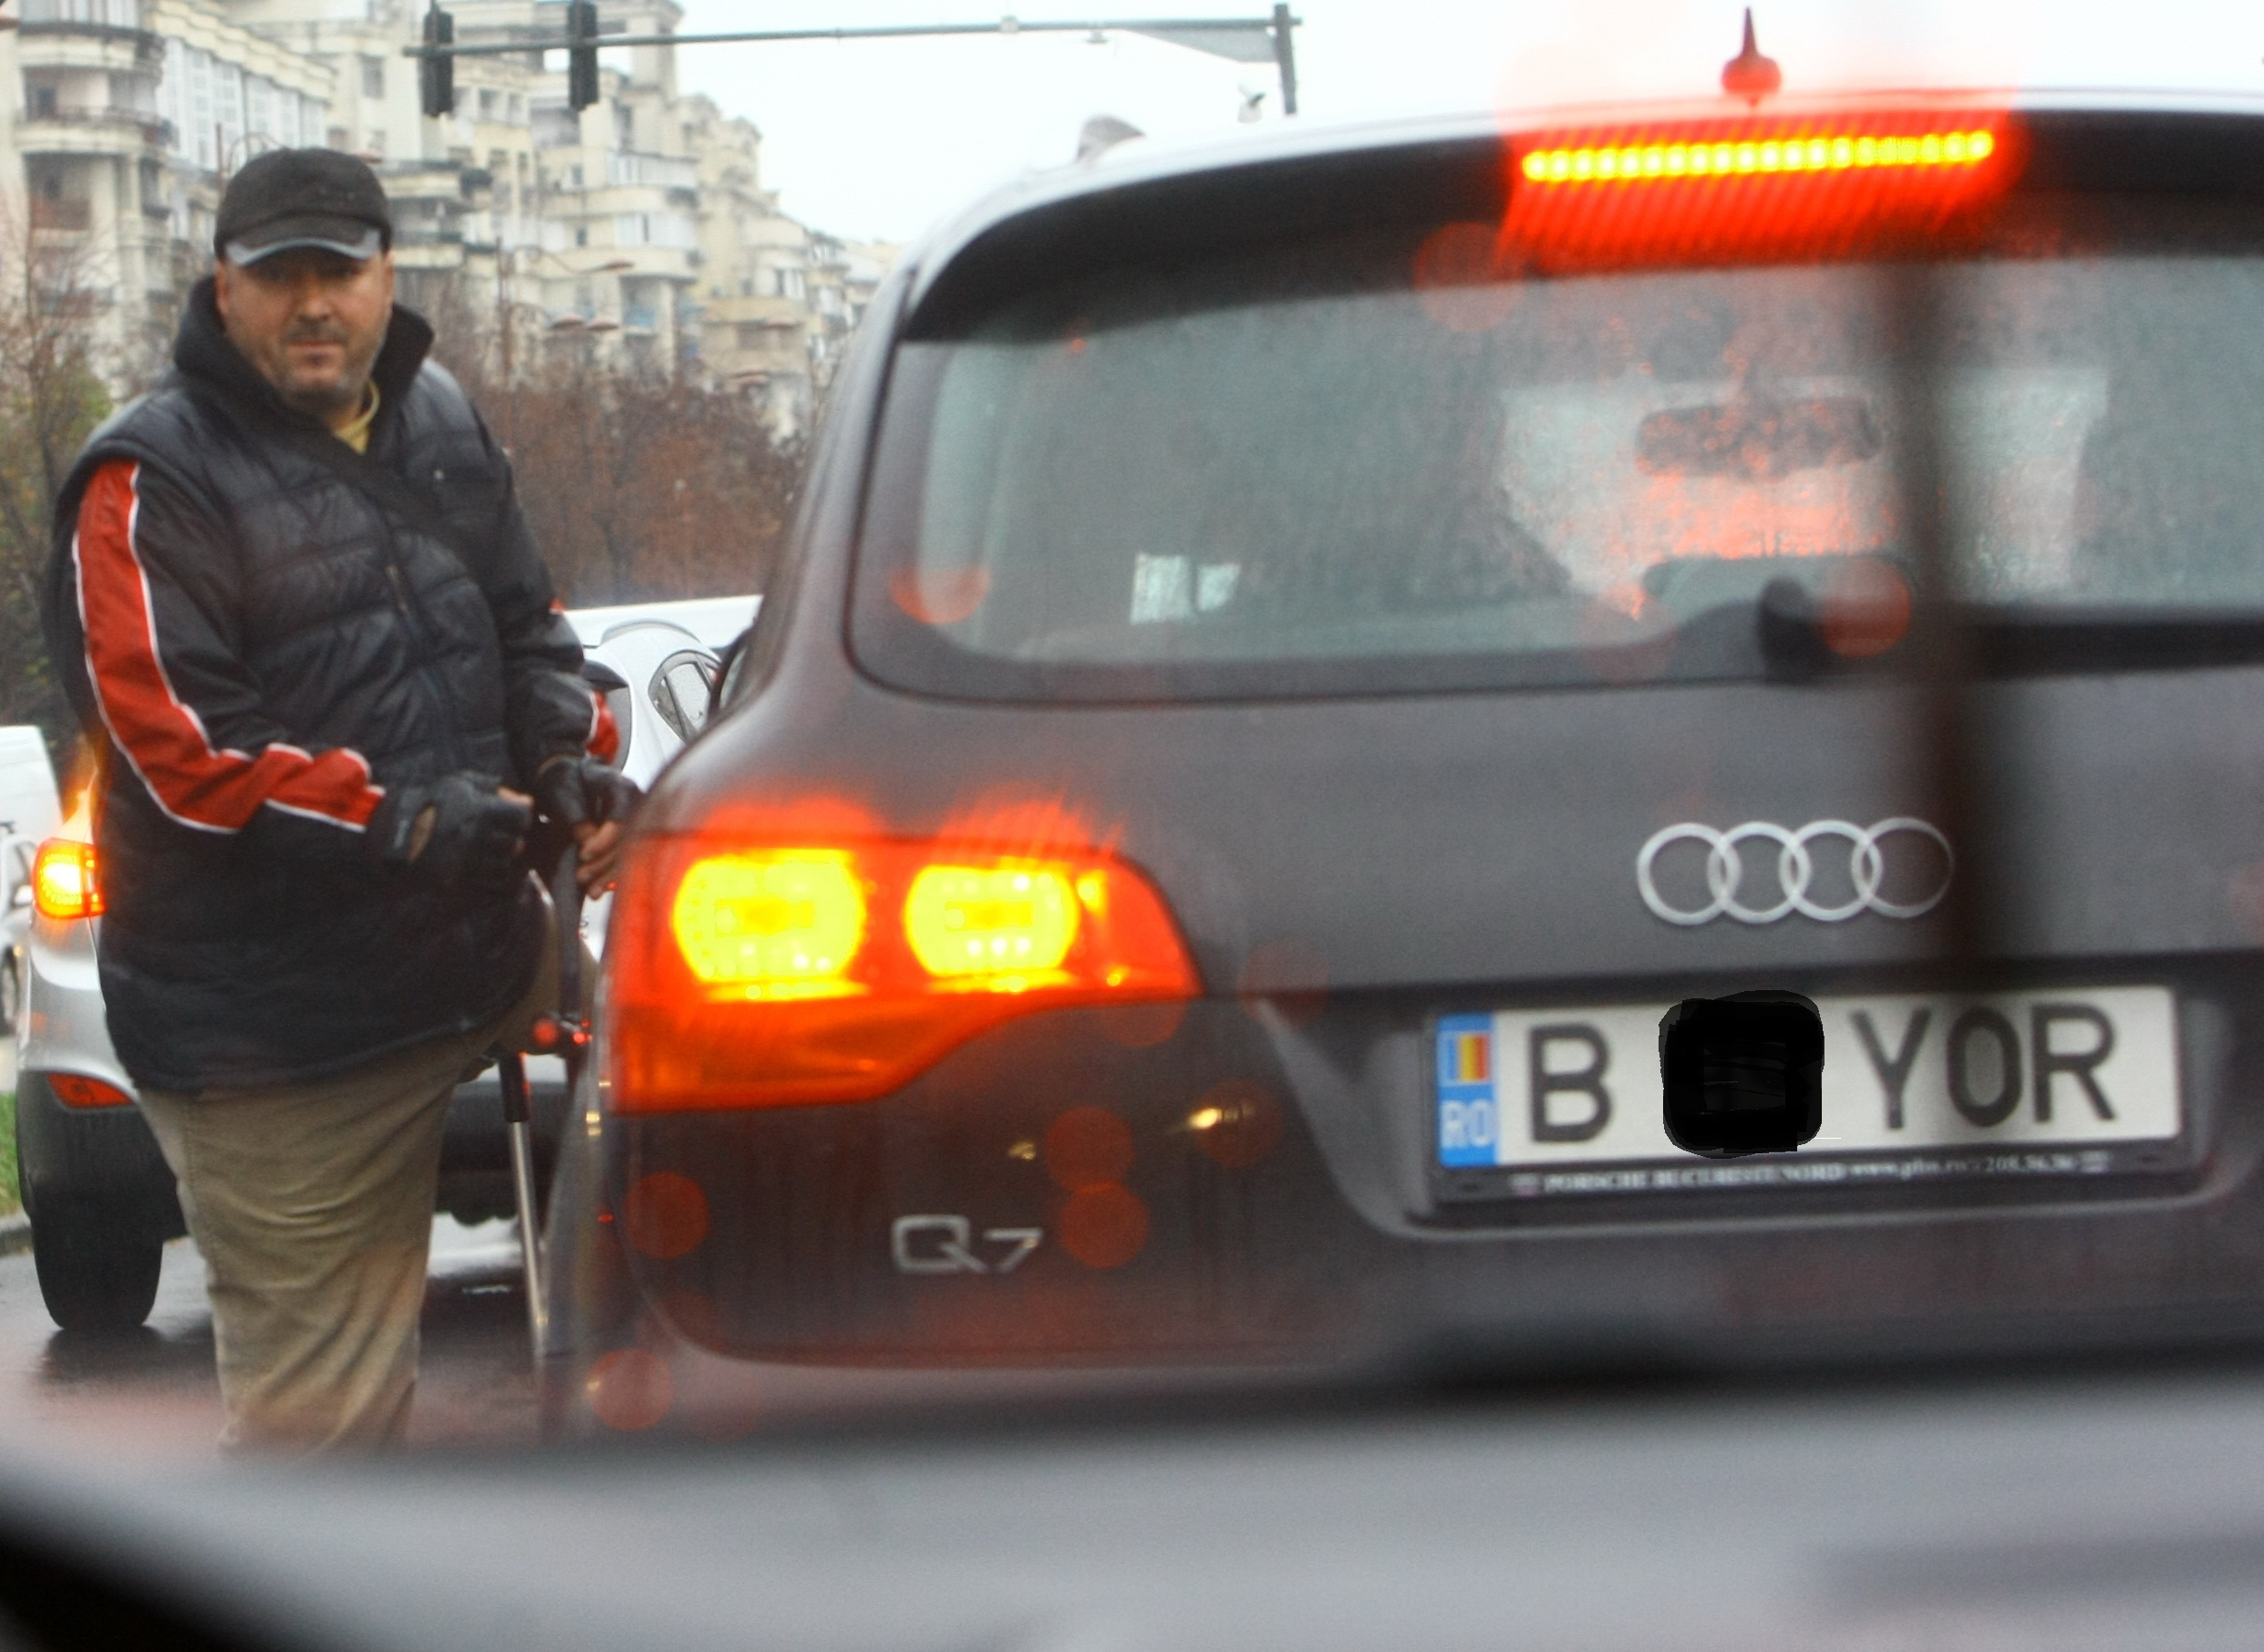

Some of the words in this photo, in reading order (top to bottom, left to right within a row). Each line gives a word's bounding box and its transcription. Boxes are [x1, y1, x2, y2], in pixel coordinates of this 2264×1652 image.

[1529, 1022, 1612, 1143] B
[1850, 1004, 2115, 1129] YOR
[1441, 1100, 1496, 1147] RO
[892, 1213, 1043, 1274] Q7
